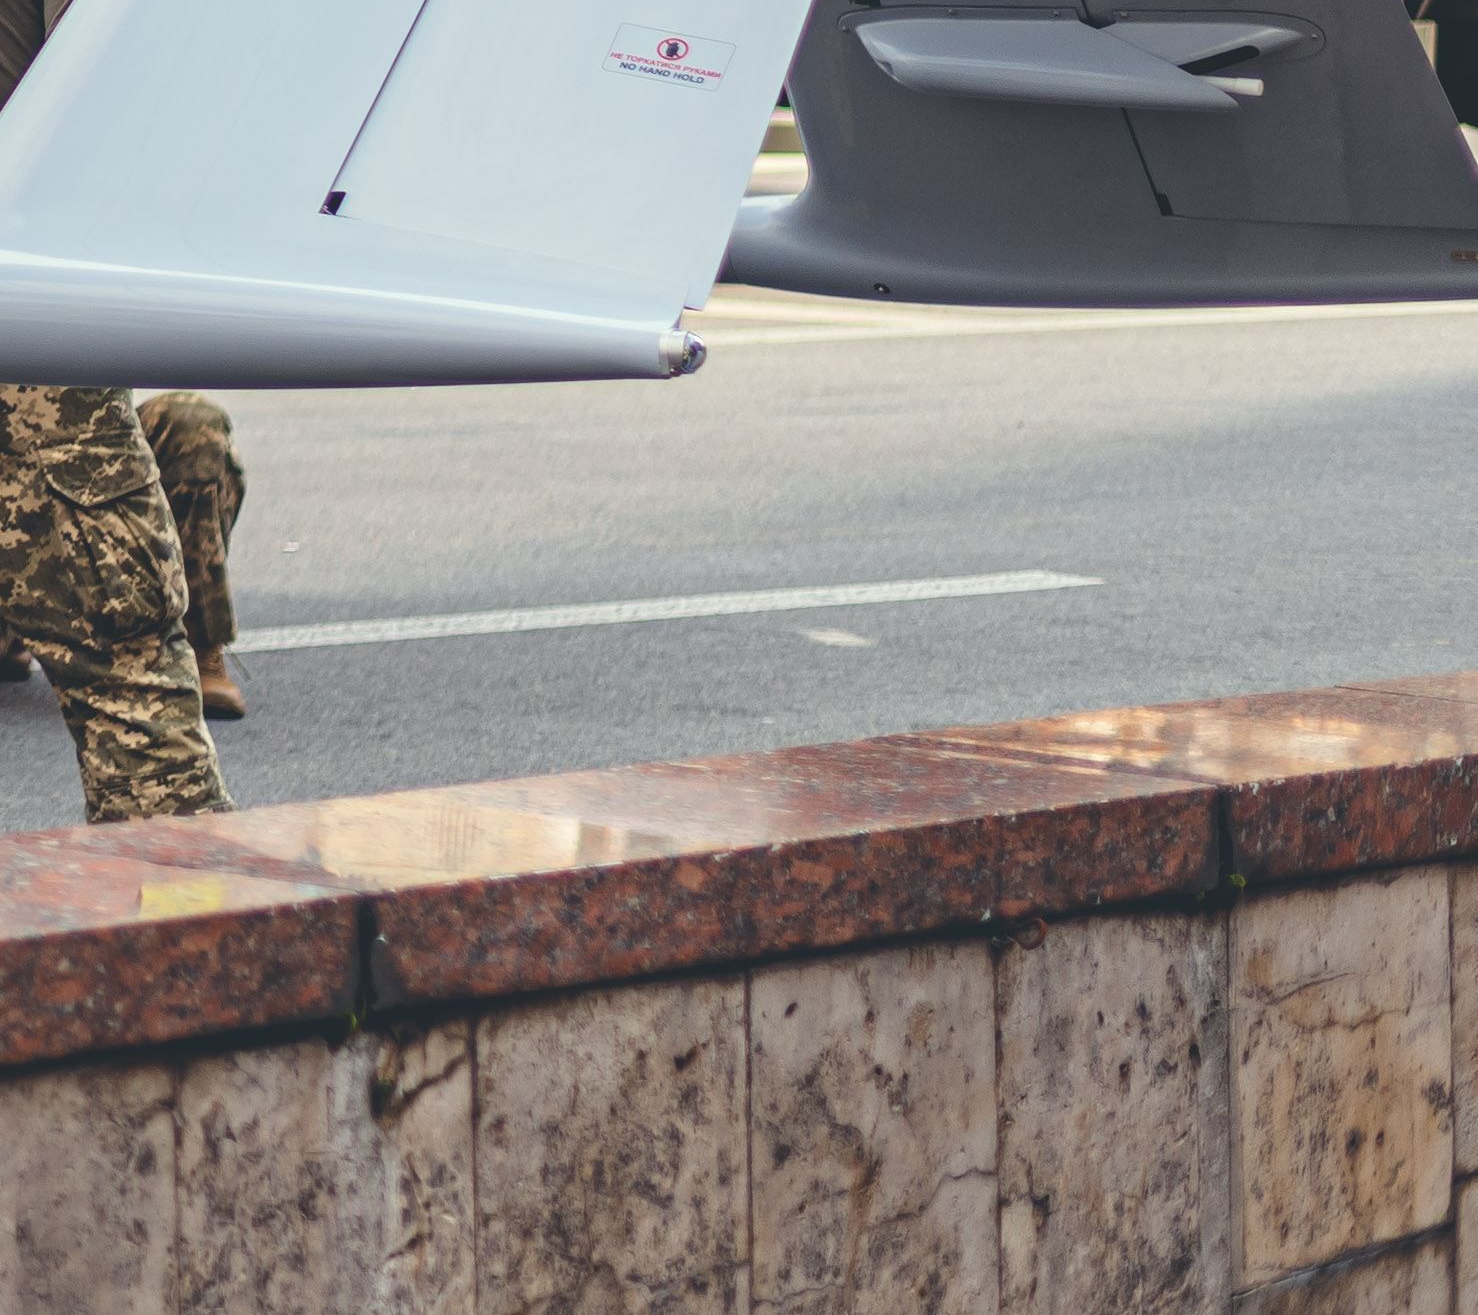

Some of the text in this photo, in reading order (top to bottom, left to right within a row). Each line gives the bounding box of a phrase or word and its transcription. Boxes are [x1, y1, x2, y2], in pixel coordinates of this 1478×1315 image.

[609, 51, 624, 59] НЕ
[619, 61, 705, 84] NO HAND HOLD
